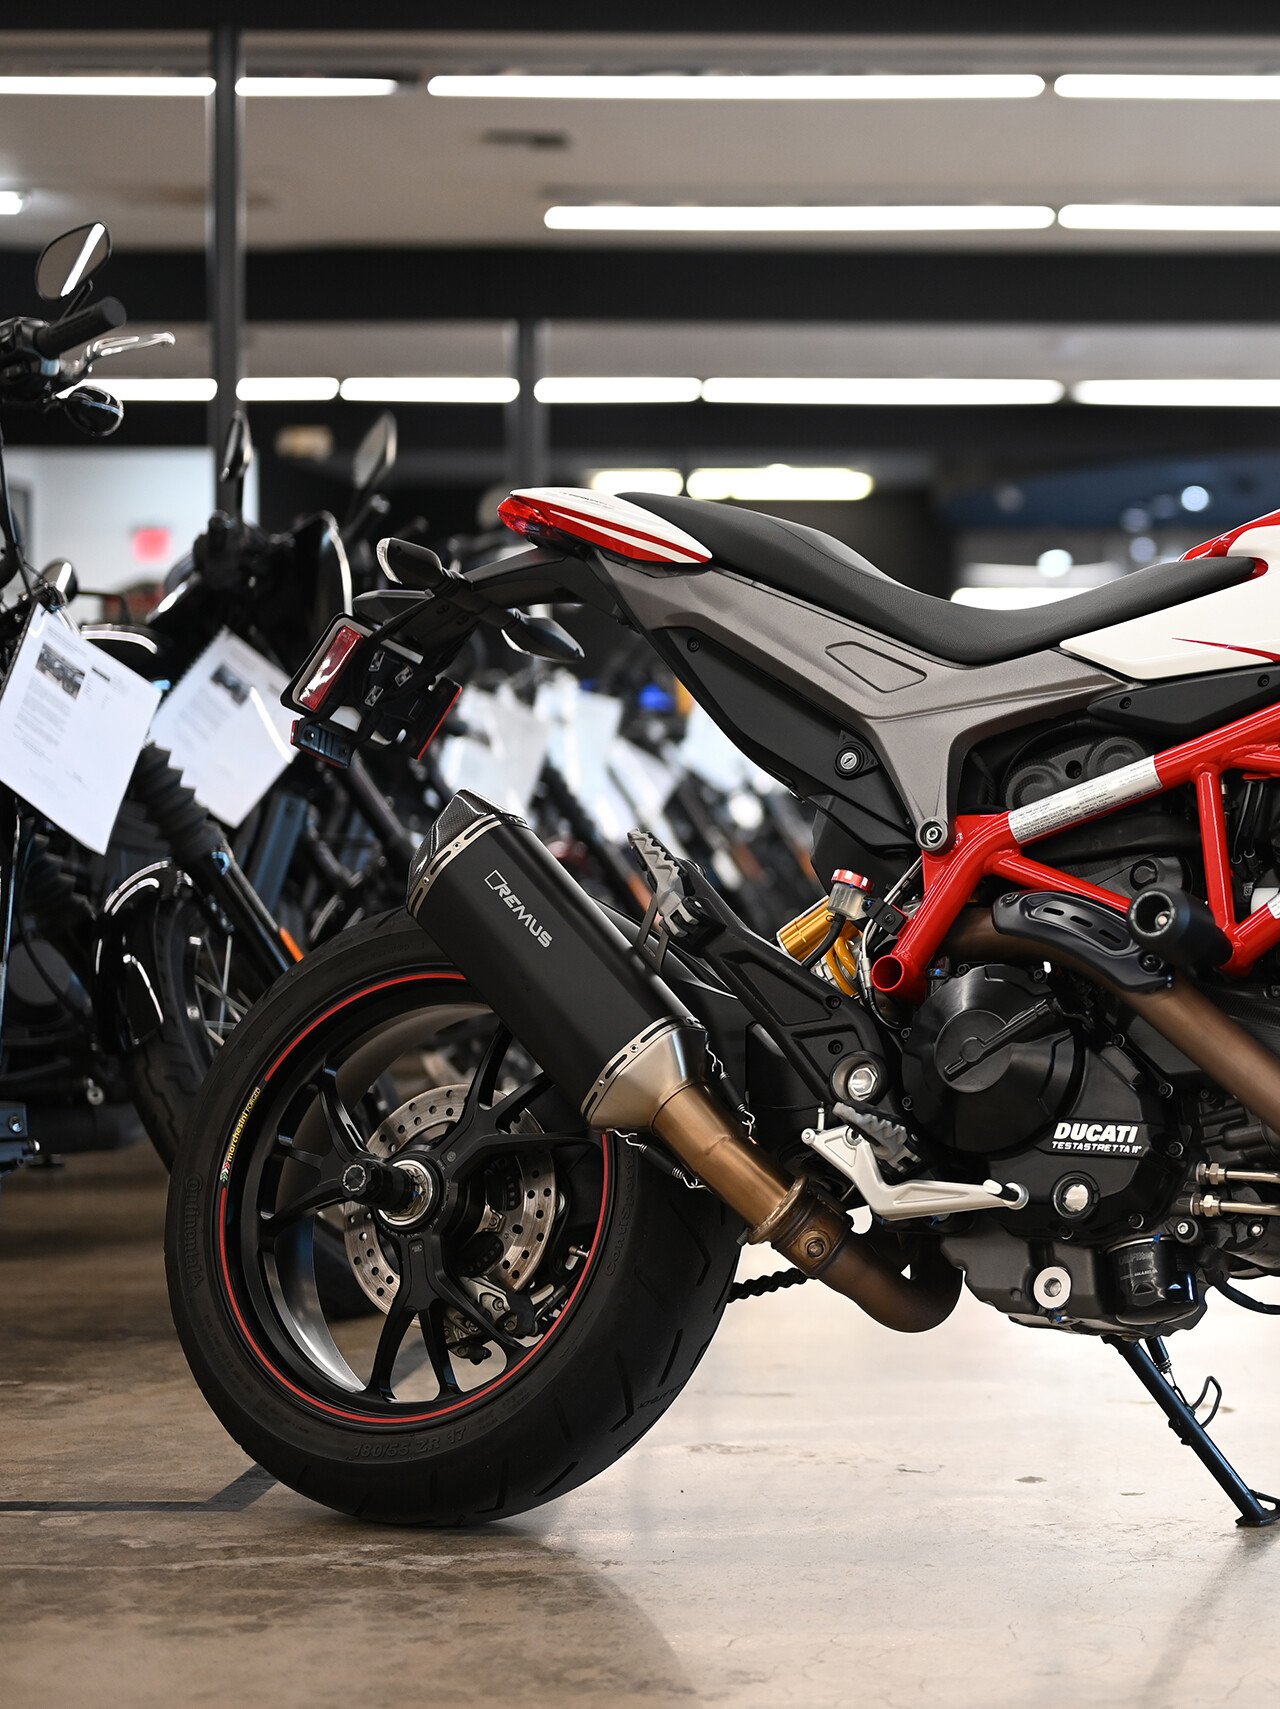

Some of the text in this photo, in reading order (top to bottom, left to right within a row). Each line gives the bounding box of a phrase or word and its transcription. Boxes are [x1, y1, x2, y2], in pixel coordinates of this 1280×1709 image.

[492, 882, 553, 948] REMUS
[226, 1110, 249, 1162] marchesini
[1052, 1141, 1131, 1153] TESTASTRETTA
[1053, 1122, 1139, 1143] DUCATI
